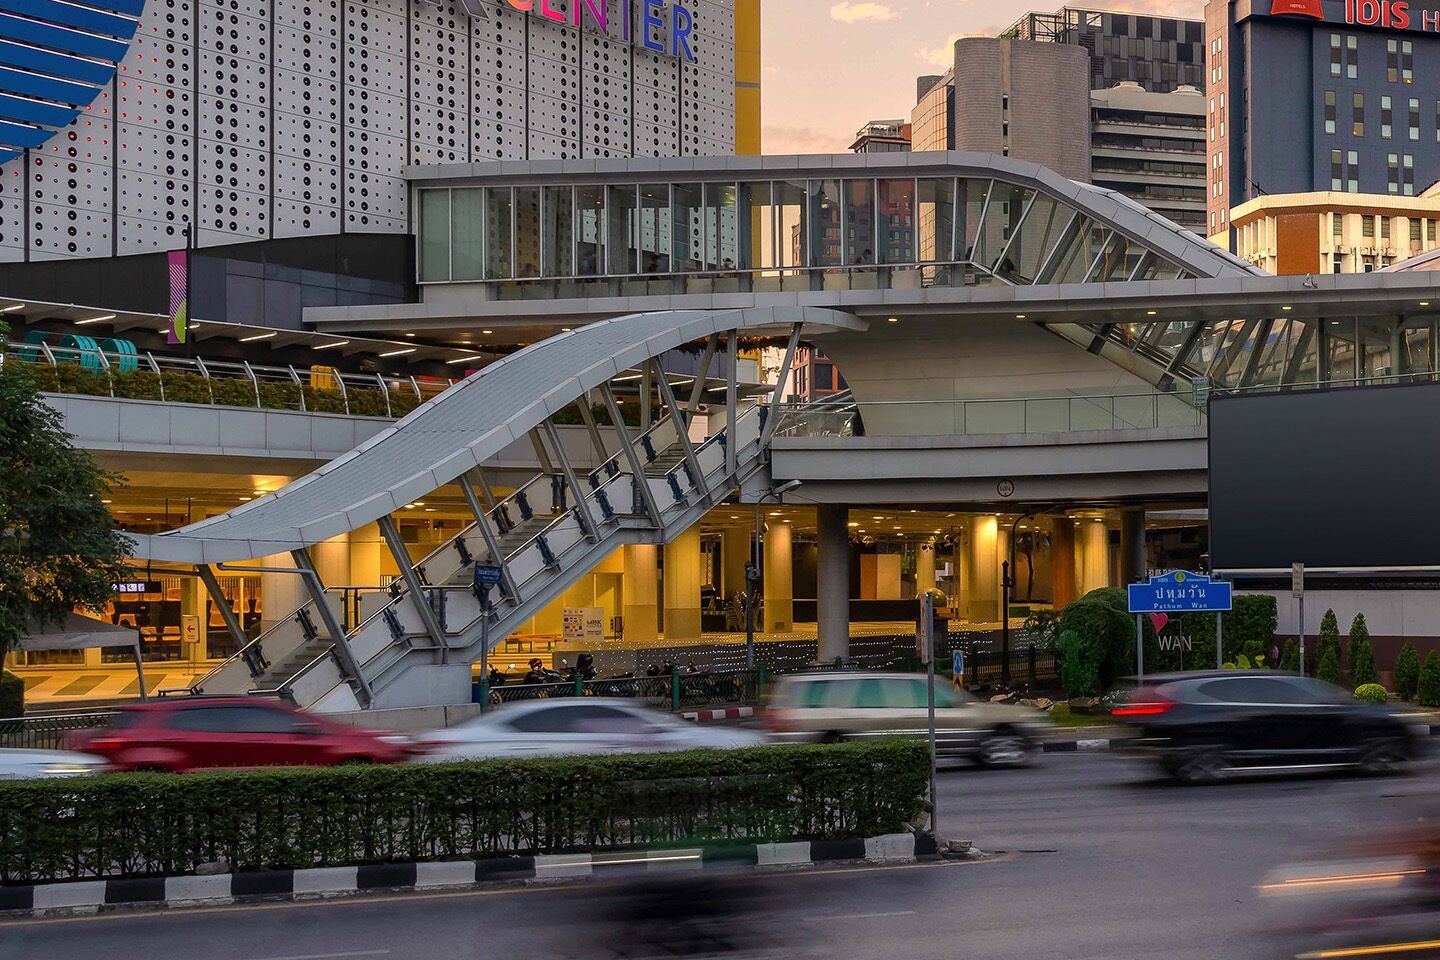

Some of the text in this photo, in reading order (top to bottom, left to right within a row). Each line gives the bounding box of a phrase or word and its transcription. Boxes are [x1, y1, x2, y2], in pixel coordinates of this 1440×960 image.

[1155, 584, 1206, 602] ปทุมวัน
[1157, 635, 1192, 651] WAN
